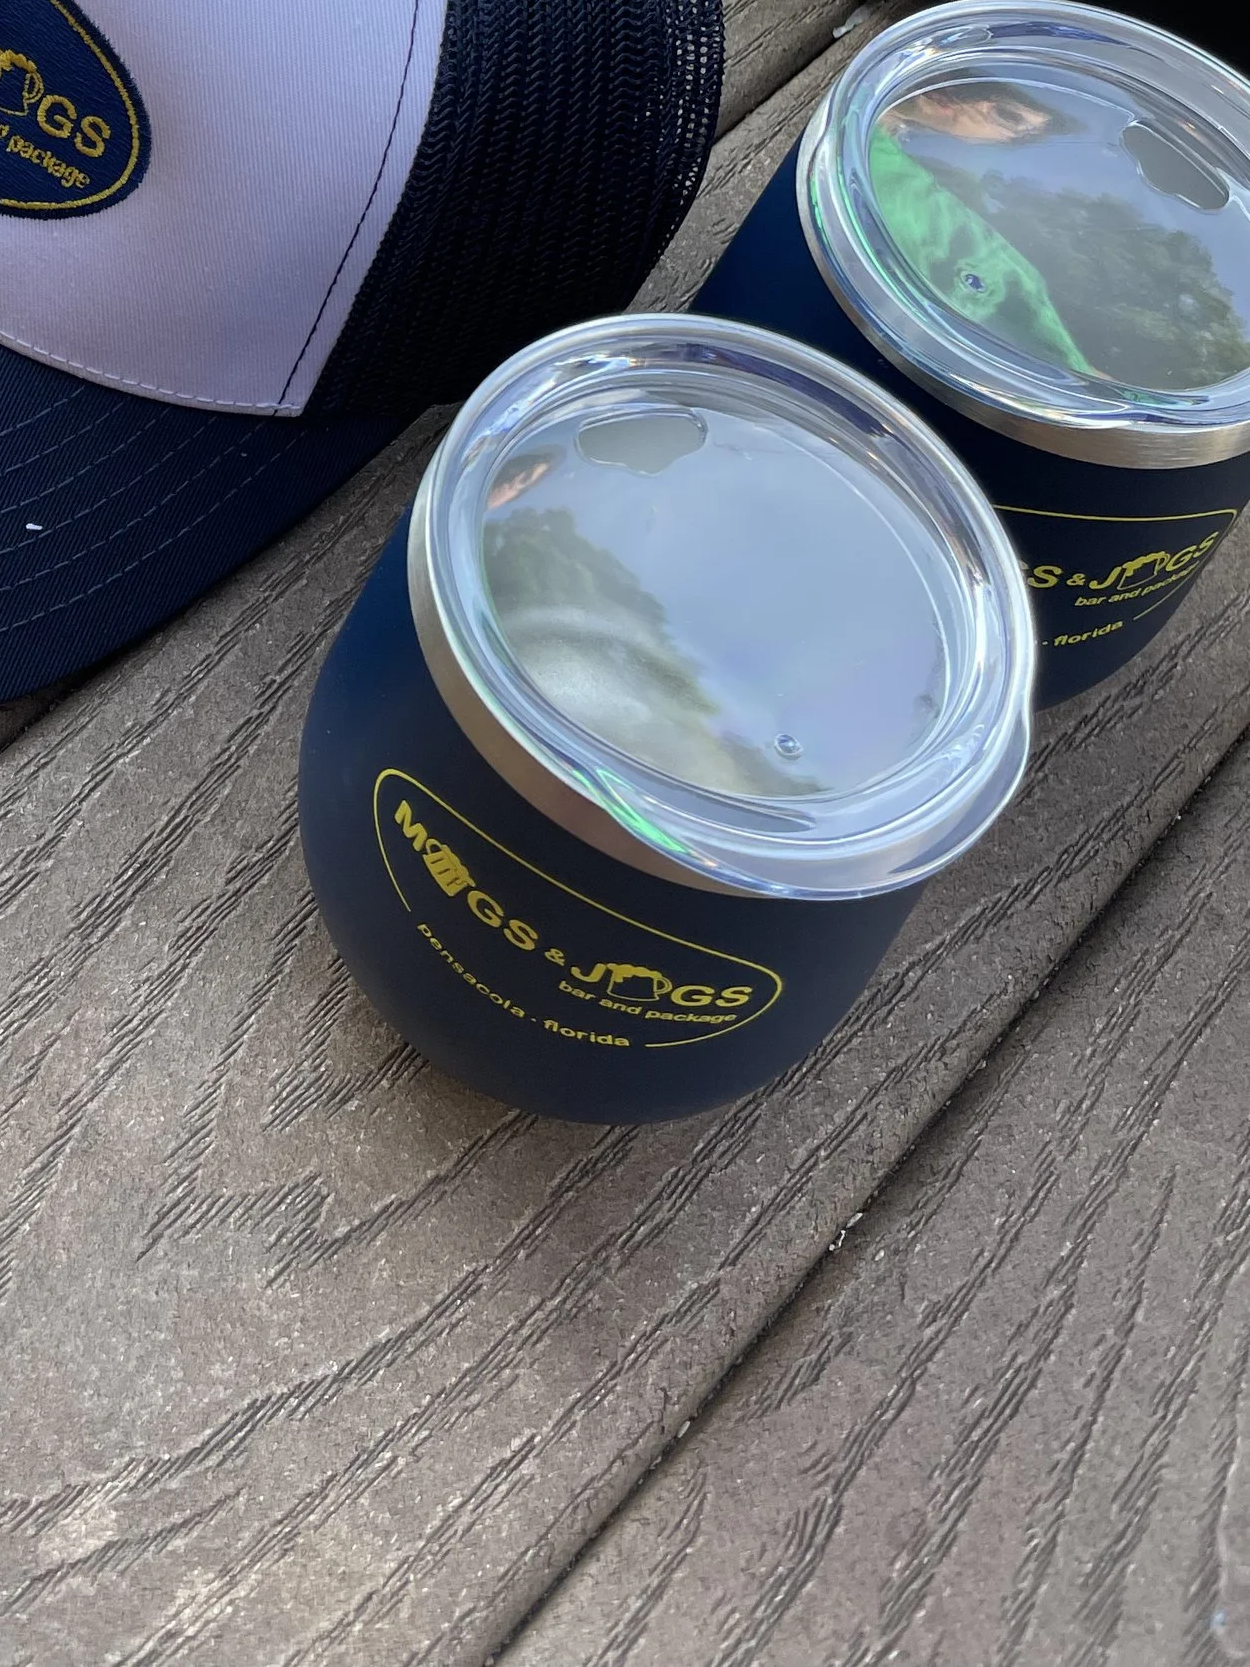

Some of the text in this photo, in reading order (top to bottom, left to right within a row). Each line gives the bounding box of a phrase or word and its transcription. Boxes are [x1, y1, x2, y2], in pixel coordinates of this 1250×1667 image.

[6, 134, 91, 189] package
[1066, 573, 1086, 587] &
[1074, 596, 1104, 607] bar
[1108, 588, 1141, 604] and
[1053, 620, 1123, 647] florida
[545, 947, 567, 967] &
[417, 922, 526, 1019] pensacola
[542, 1018, 631, 1048] florida
[557, 979, 738, 1025] bar and package
